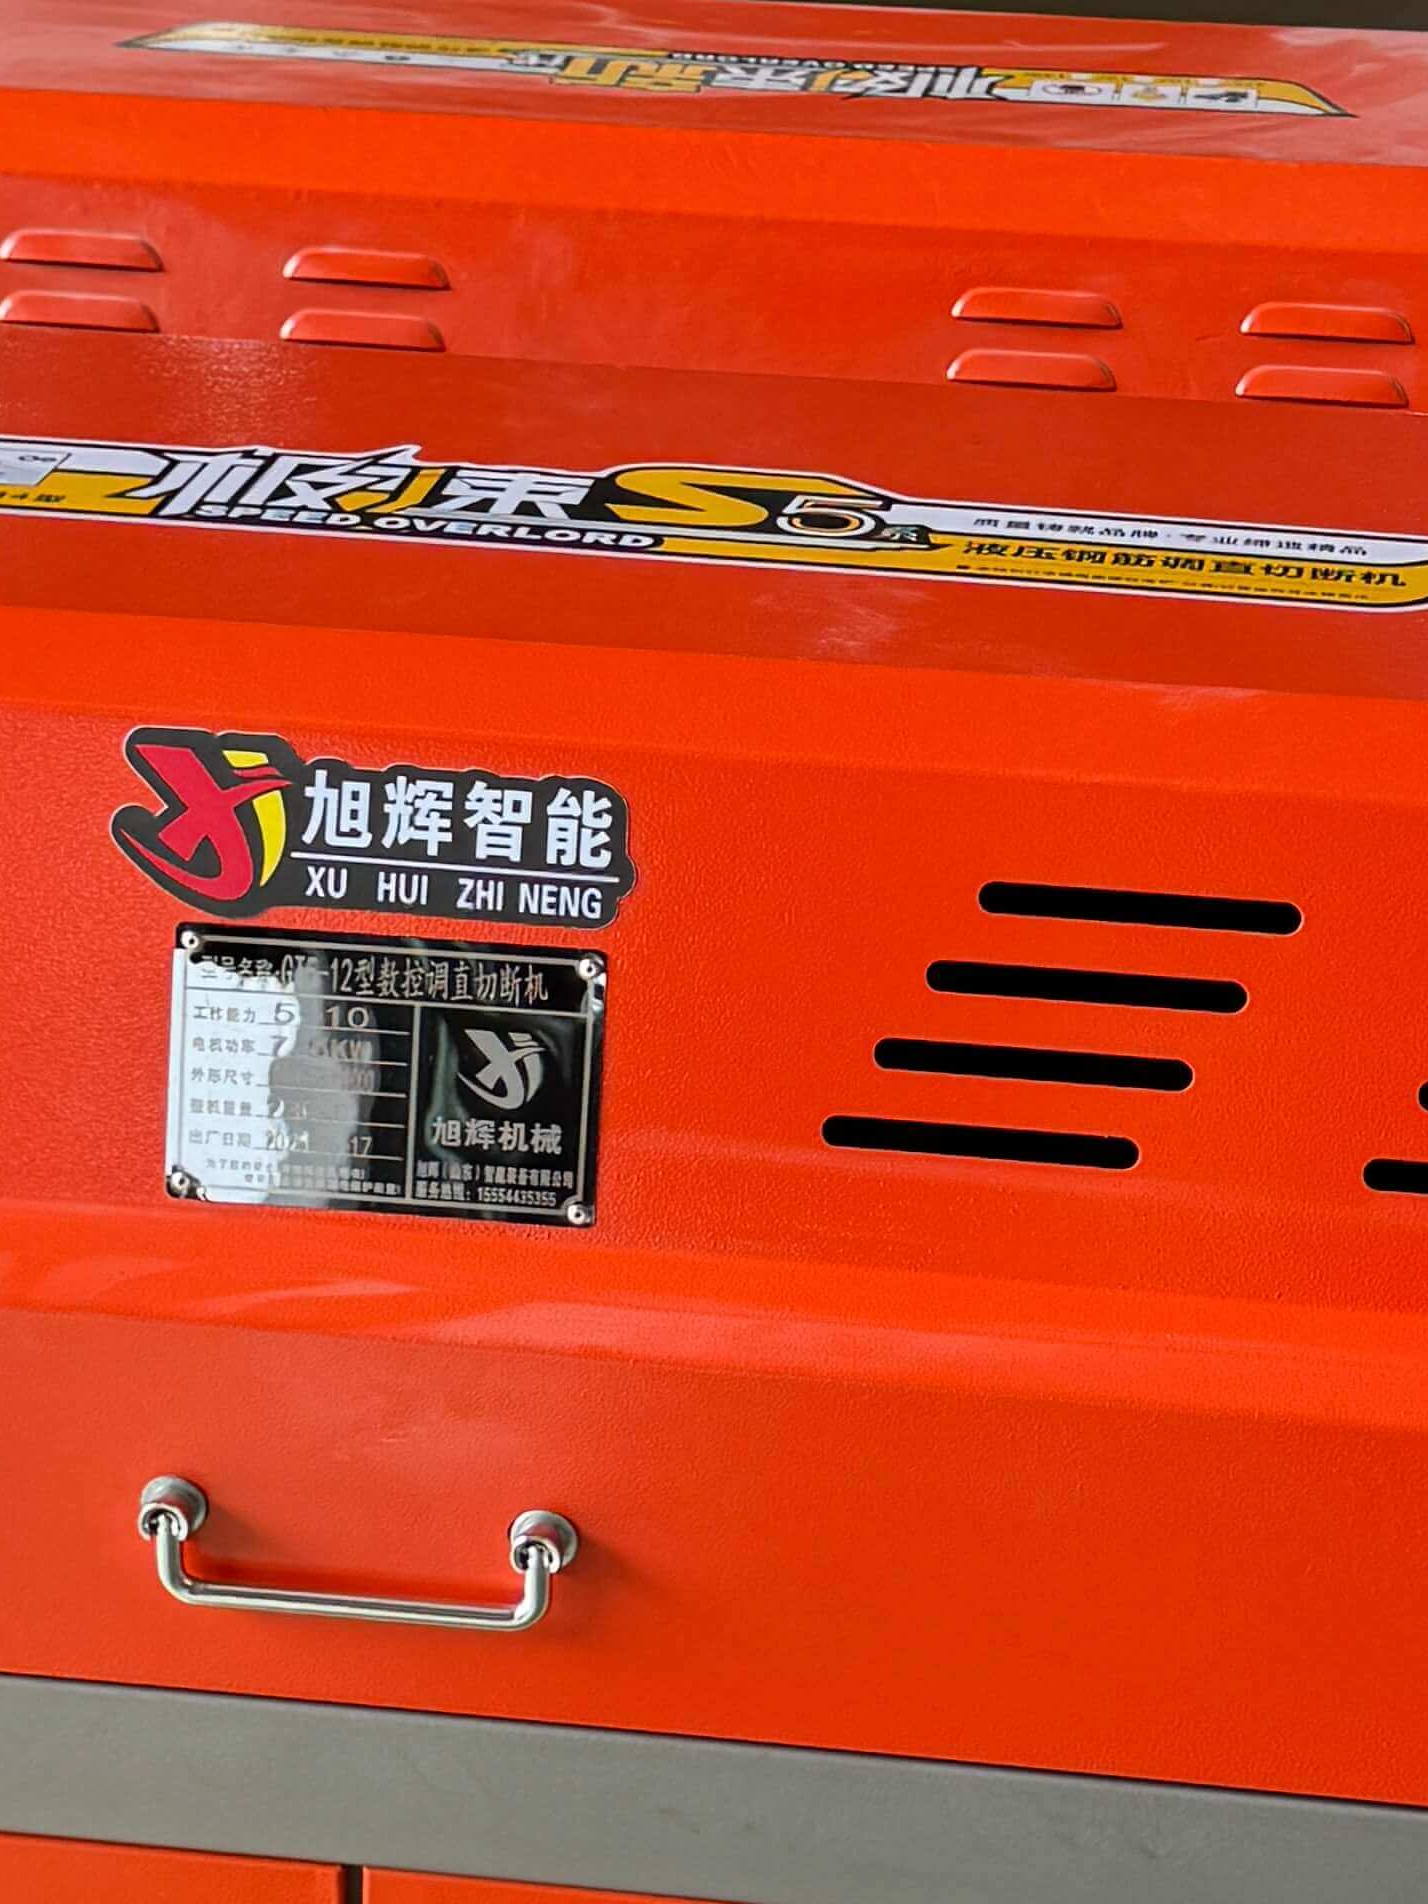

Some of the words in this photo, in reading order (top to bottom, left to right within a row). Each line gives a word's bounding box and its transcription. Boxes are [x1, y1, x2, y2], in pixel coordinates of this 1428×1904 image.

[194, 502, 362, 528] SPEED
[371, 513, 655, 548] OVERLORD
[301, 768, 614, 872] 旭辉智能
[305, 865, 348, 899] XU
[376, 871, 429, 906] HUI
[456, 877, 504, 912] ZHI
[517, 885, 604, 920] NENG
[431, 1116, 563, 1155] 旭辉机械
